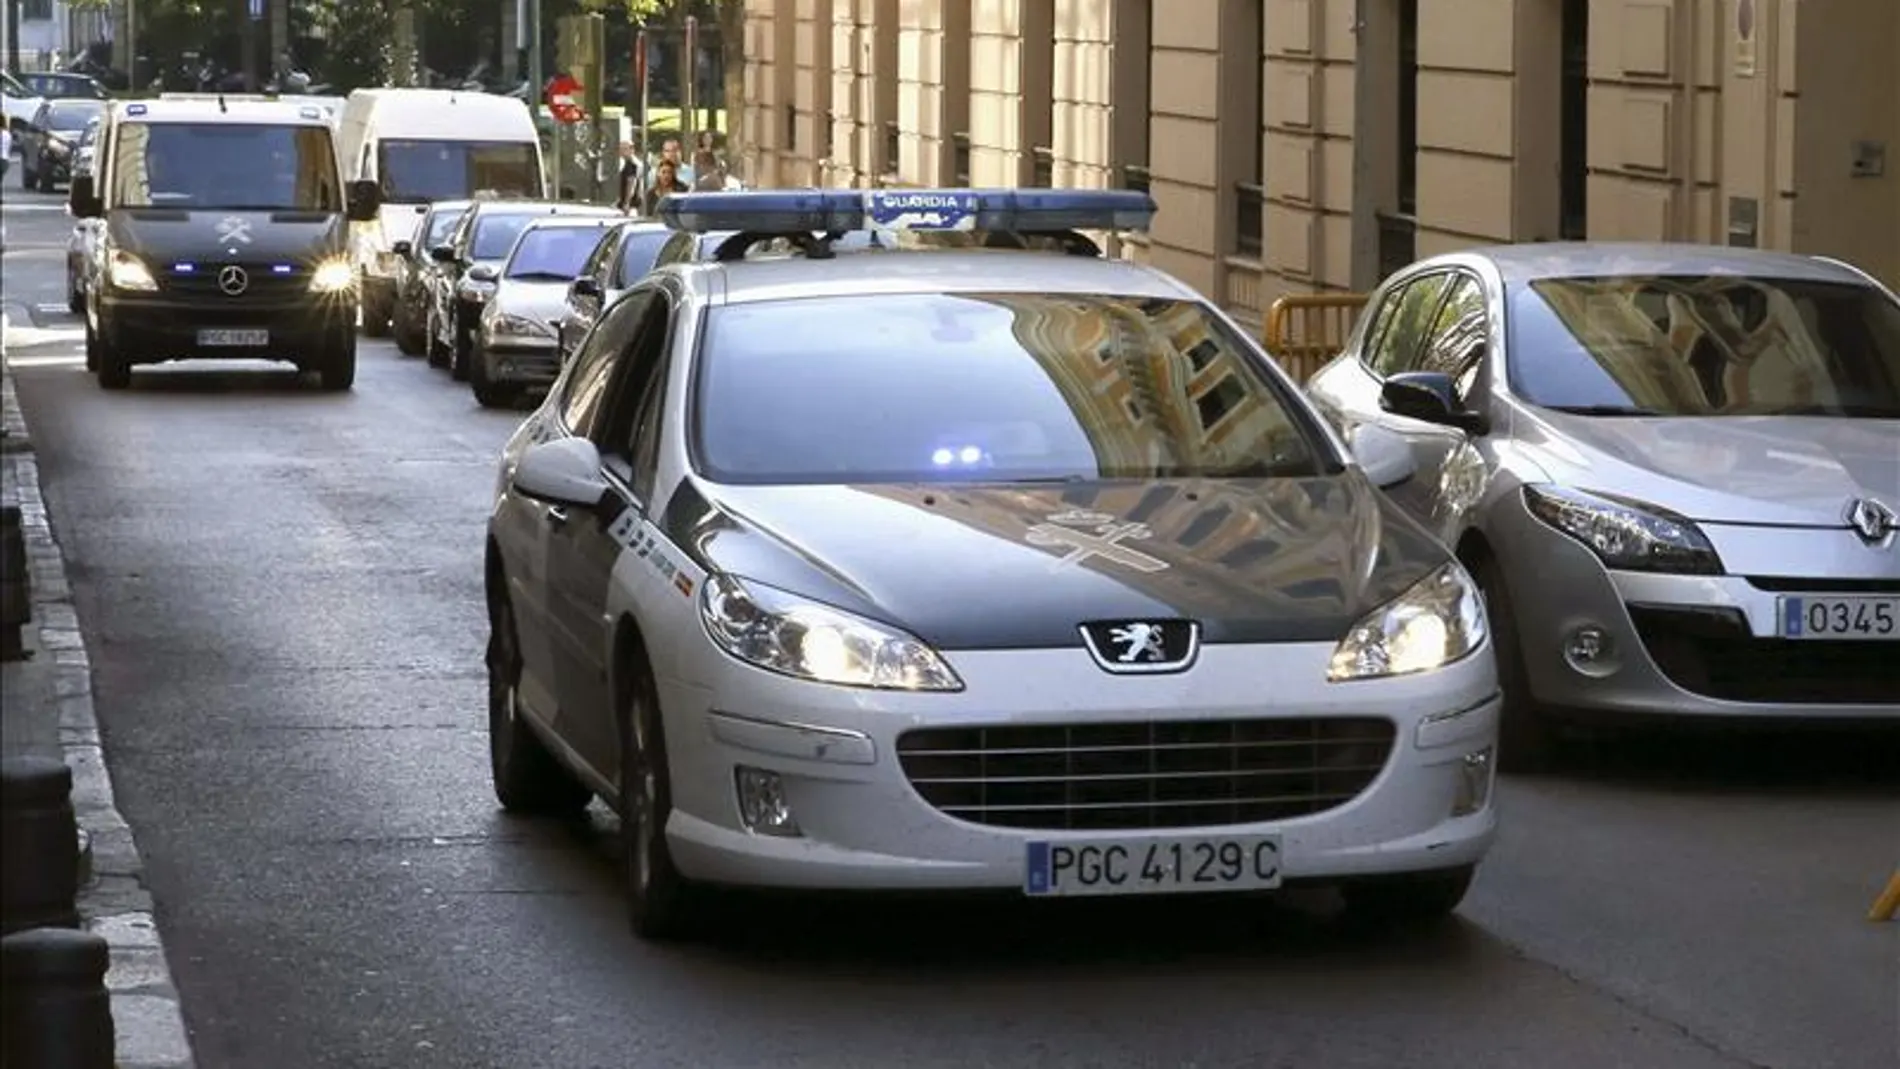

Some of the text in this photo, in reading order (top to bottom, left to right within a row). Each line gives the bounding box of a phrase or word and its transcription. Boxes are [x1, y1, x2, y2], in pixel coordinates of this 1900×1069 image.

[882, 196, 958, 208] GUARDIA
[1809, 602, 1893, 634] 0345
[1051, 845, 1129, 887] PGC
[1140, 841, 1243, 883] 4129
[1254, 840, 1278, 880] C
